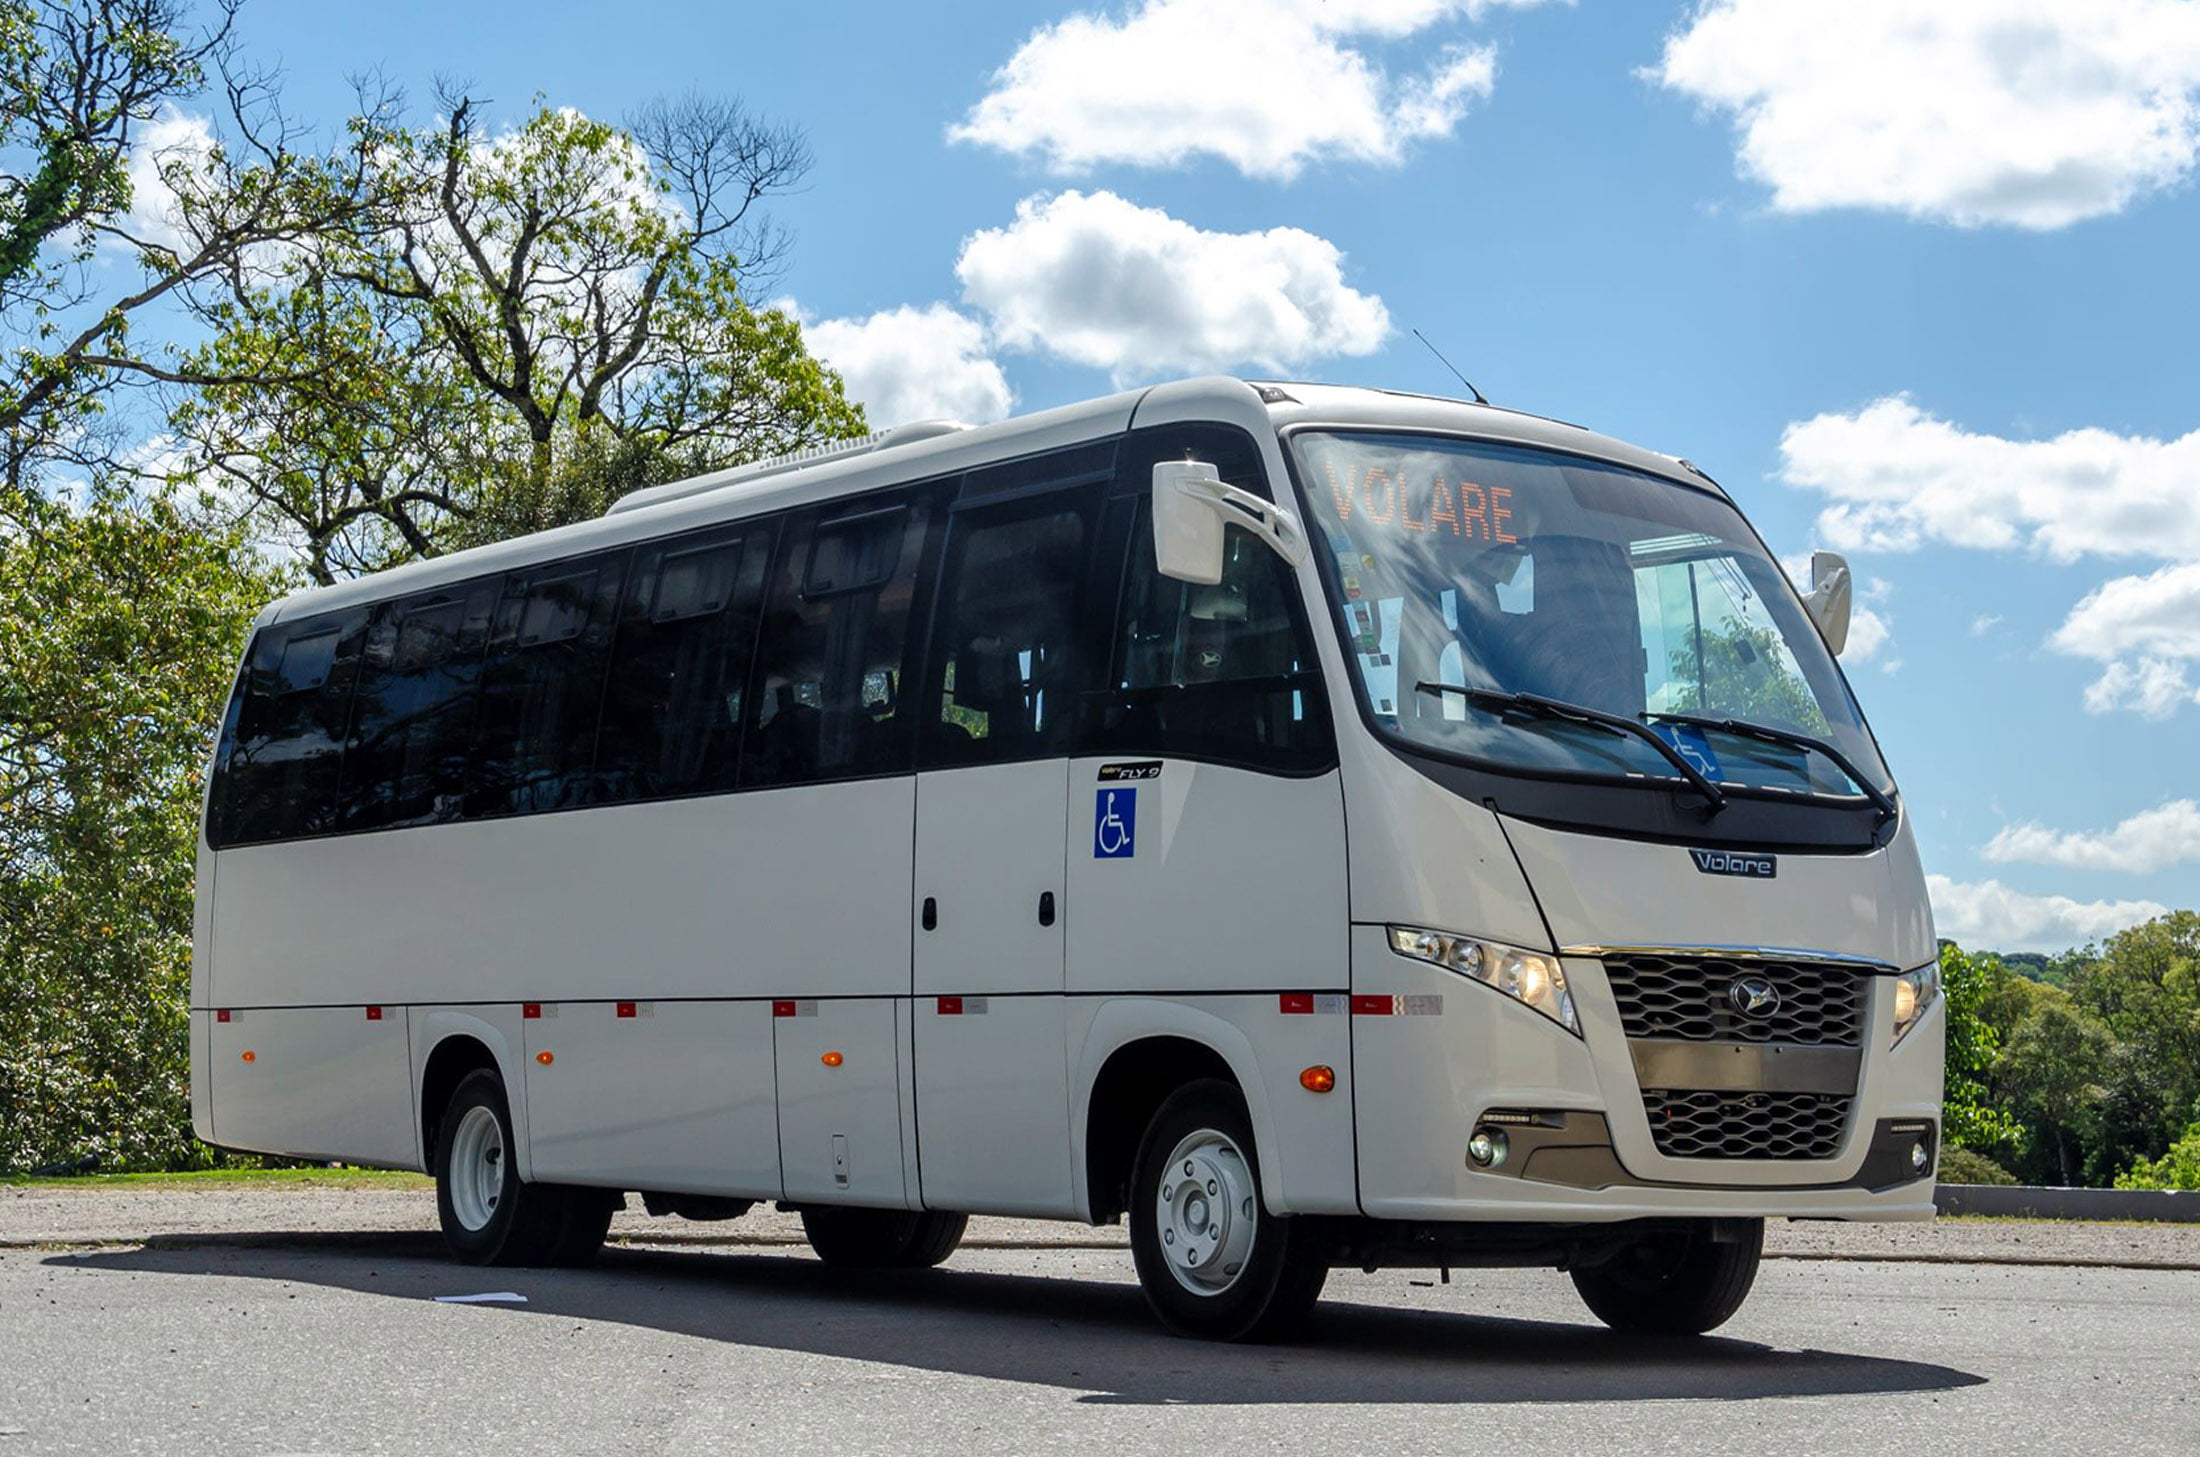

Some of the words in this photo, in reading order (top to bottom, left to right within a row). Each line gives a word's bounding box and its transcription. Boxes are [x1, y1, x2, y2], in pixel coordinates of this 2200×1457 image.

[1325, 458, 1518, 544] VOLARE
[1119, 768, 1146, 779] FLY
[1148, 767, 1160, 778] 9
[1696, 852, 1772, 875] Volare
